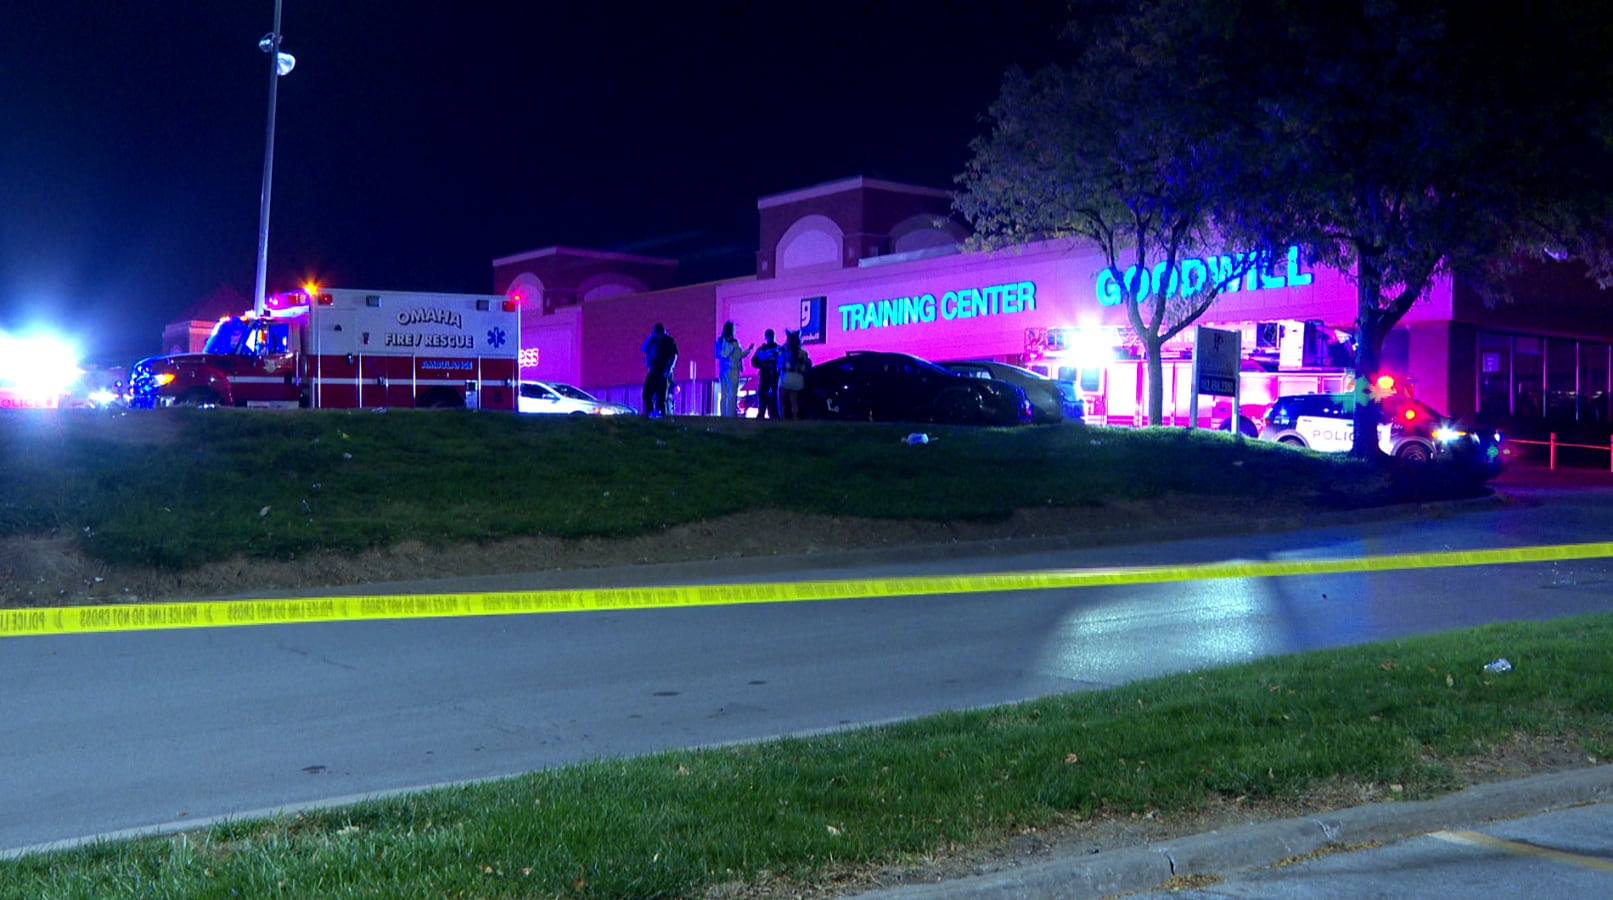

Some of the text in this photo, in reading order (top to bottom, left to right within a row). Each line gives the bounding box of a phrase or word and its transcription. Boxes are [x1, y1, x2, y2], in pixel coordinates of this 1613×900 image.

[1096, 246, 1313, 306] GOODWILL
[838, 281, 1037, 331] TRAINING CENTER
[396, 308, 462, 328] OMAHA
[424, 334, 474, 348] RESCUE
[0, 399, 43, 408] OLICE
[1313, 429, 1355, 441] POLIC
